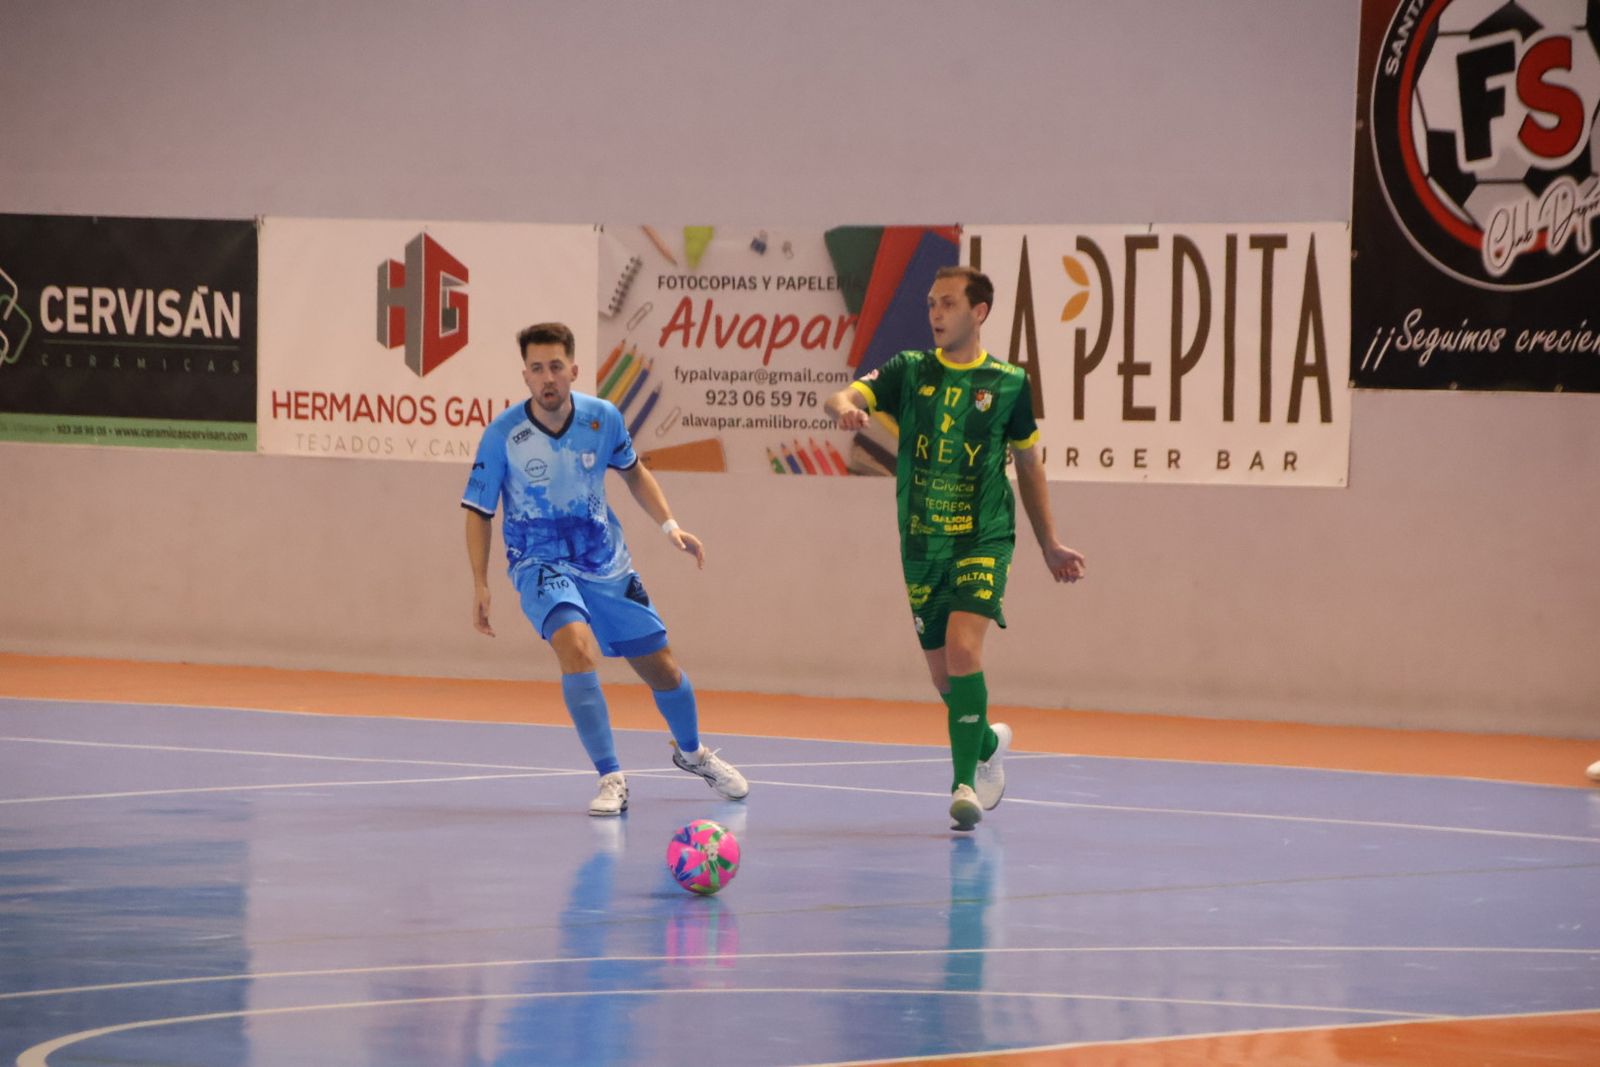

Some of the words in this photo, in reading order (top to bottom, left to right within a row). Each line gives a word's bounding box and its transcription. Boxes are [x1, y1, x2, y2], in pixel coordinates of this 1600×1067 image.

[1456, 35, 1585, 163] FS
[657, 275, 758, 291] FOTOCOPIAS
[762, 276, 772, 290] Y
[776, 276, 862, 291] PAPELE
[39, 285, 241, 339] CERVISÁN
[658, 295, 859, 367] Alvapar
[969, 234, 1045, 420] A
[1060, 232, 1333, 424] PEPITA
[674, 366, 850, 385] fypalvapar@gmail.com
[271, 391, 438, 427] HERMANOS
[444, 396, 511, 428] GAL
[705, 390, 738, 406] 923
[742, 390, 766, 407] 06
[770, 391, 793, 407] 59
[796, 391, 818, 408] 76
[943, 386, 963, 408] 17
[295, 433, 394, 454] TEJADOS
[405, 437, 420, 453] Y
[915, 434, 982, 467] REY
[1004, 446, 1182, 469] RGER
[1215, 449, 1299, 472] BAR
